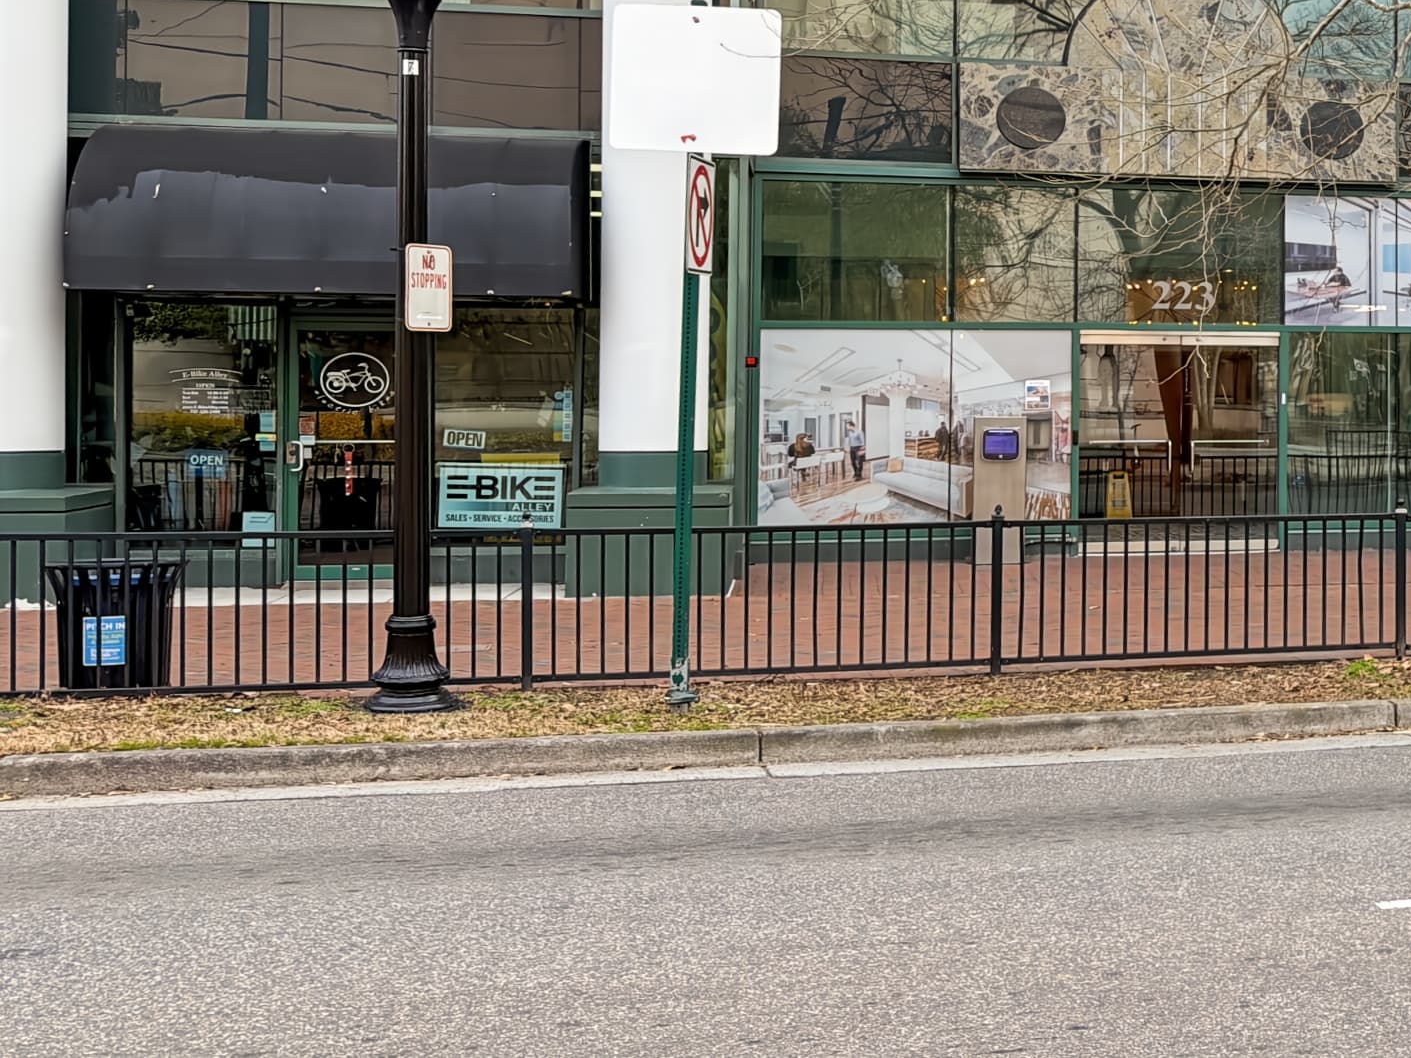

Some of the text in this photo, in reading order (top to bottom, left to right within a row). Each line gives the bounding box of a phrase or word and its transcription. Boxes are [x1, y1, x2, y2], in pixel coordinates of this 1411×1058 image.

[422, 254, 436, 270] NO
[411, 272, 447, 289] STOPPING
[1152, 280, 1216, 312] 223
[447, 431, 482, 447] OPEN
[190, 455, 223, 465] OPEN
[512, 503, 552, 511] ALLEY
[446, 513, 468, 522] SALES
[473, 514, 502, 522] SERVICE
